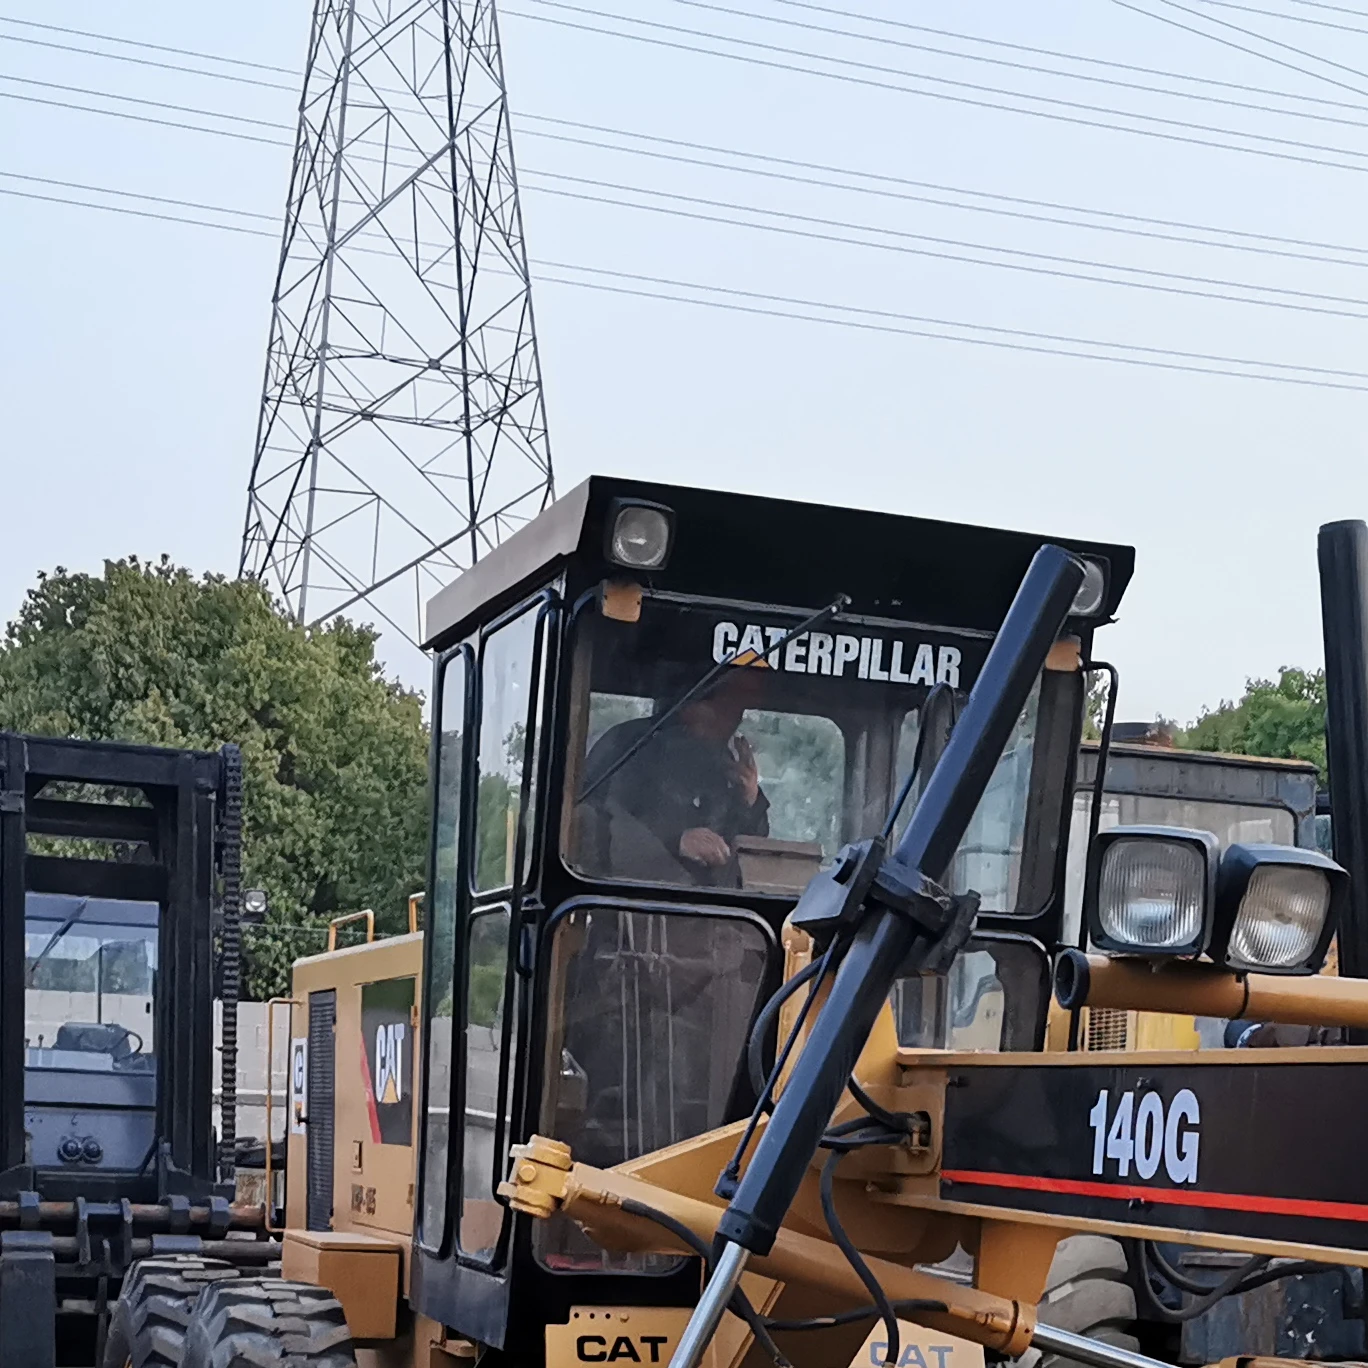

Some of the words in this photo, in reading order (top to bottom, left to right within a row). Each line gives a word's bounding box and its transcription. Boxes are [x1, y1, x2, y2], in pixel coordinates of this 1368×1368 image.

[713, 622, 962, 689] CATERPILLAR
[376, 1023, 405, 1102] CAT
[1089, 1088, 1200, 1184] 140G
[577, 1336, 668, 1362] CAT
